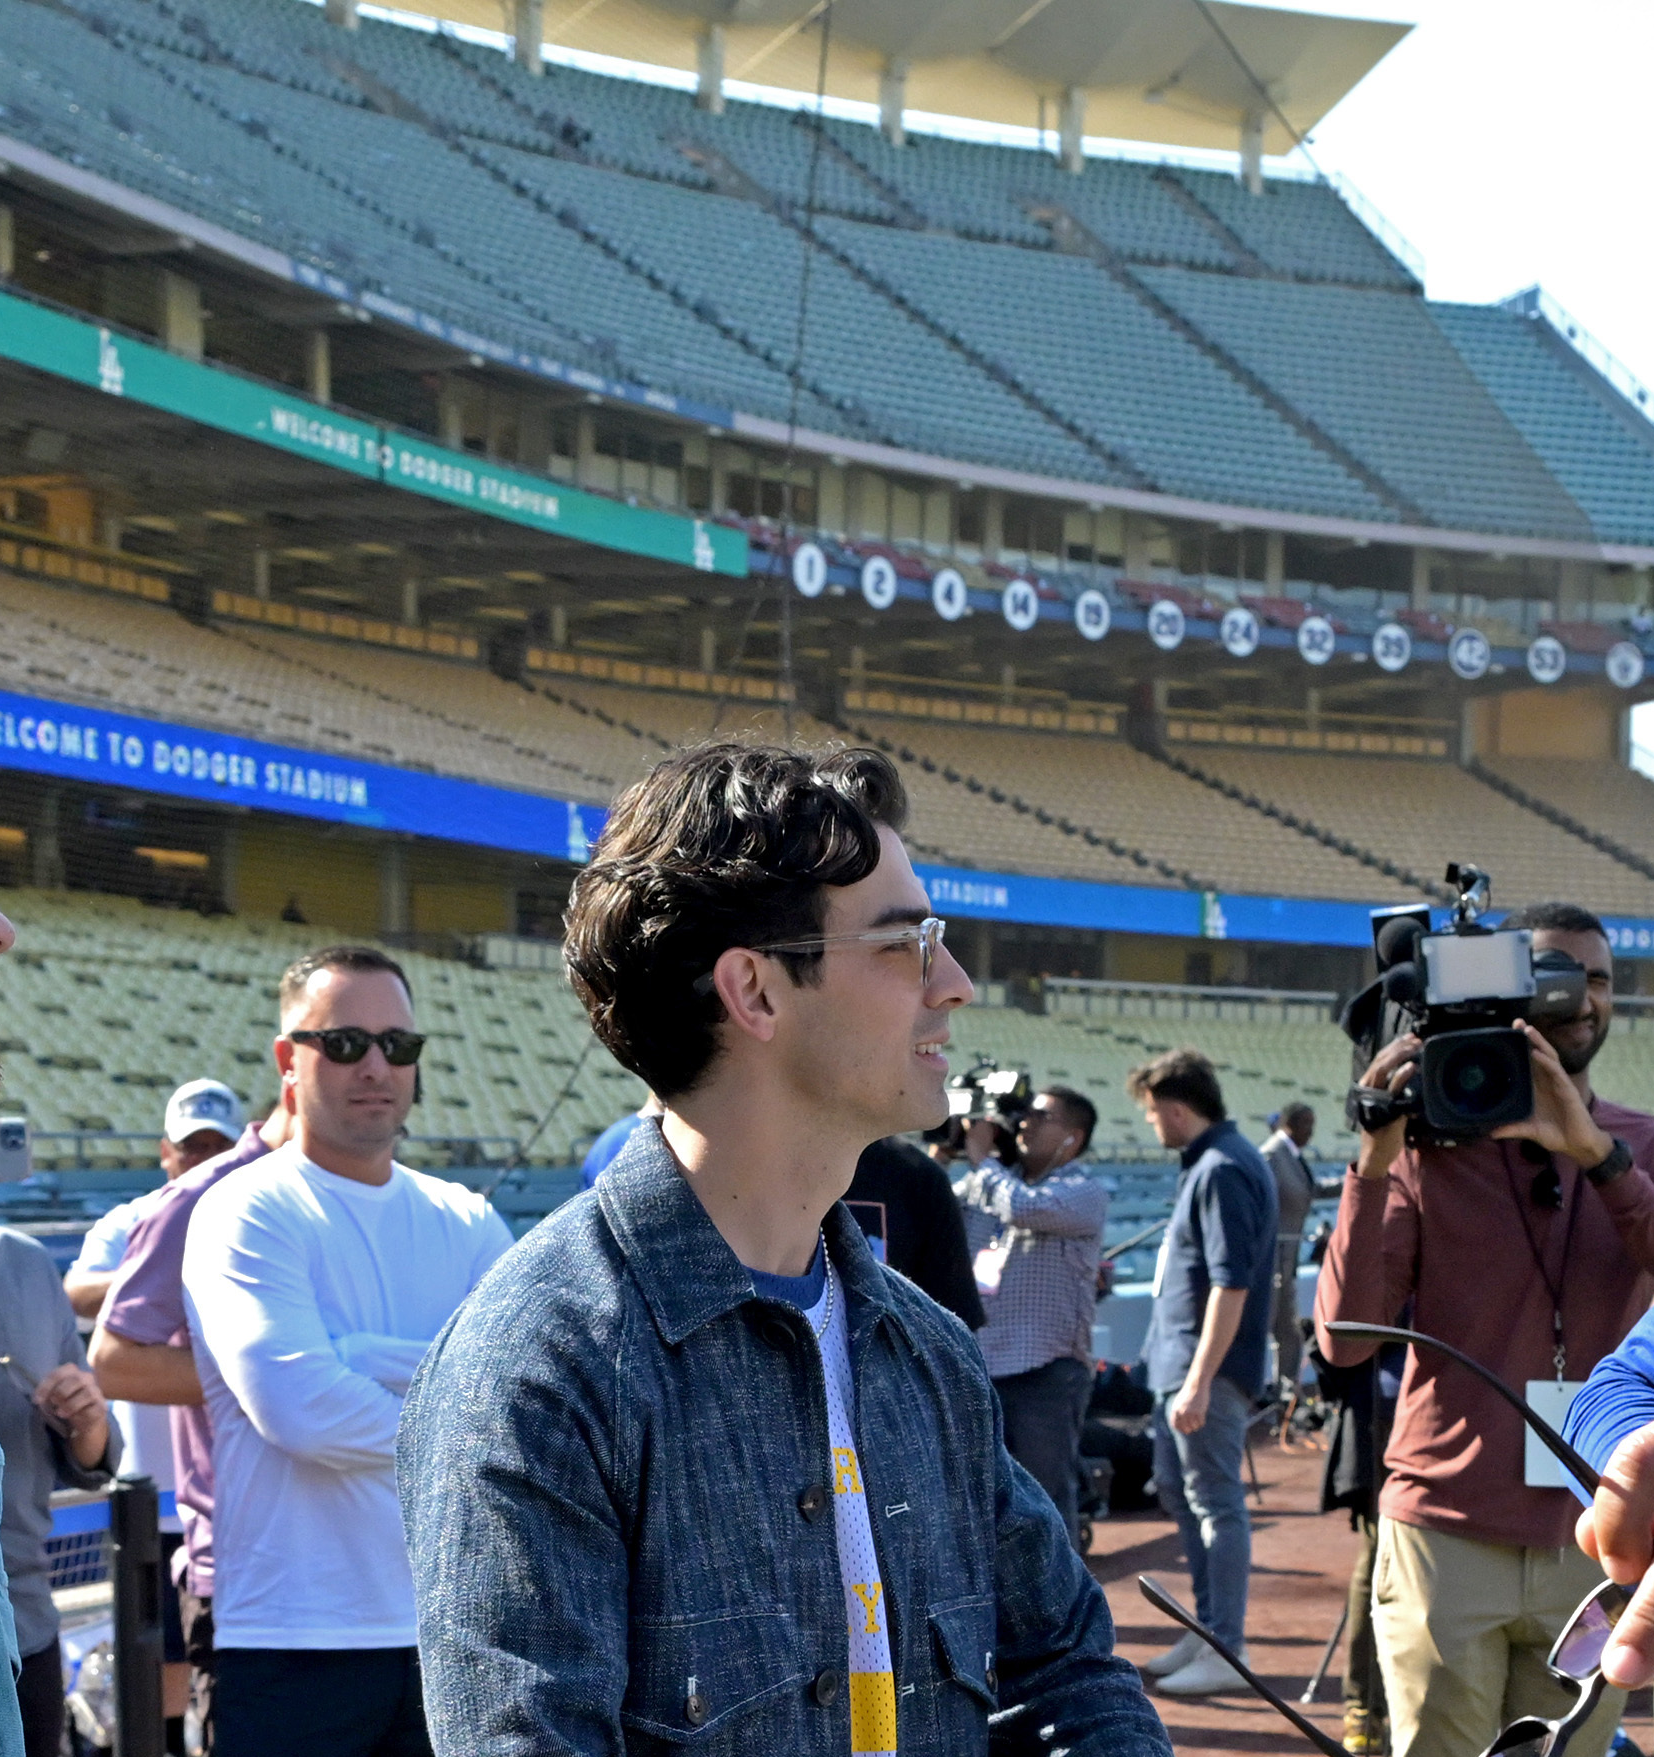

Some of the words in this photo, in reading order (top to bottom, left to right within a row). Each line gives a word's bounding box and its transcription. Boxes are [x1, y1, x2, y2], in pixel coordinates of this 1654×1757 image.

[270, 406, 360, 460] WELCOME
[364, 438, 395, 470] TO
[399, 450, 475, 495] DODGER
[478, 475, 560, 520] STADIUM
[108, 732, 145, 769] TO
[152, 740, 257, 789] DODGER
[264, 760, 368, 808] STADIUM
[930, 878, 1009, 907] STADIUM
